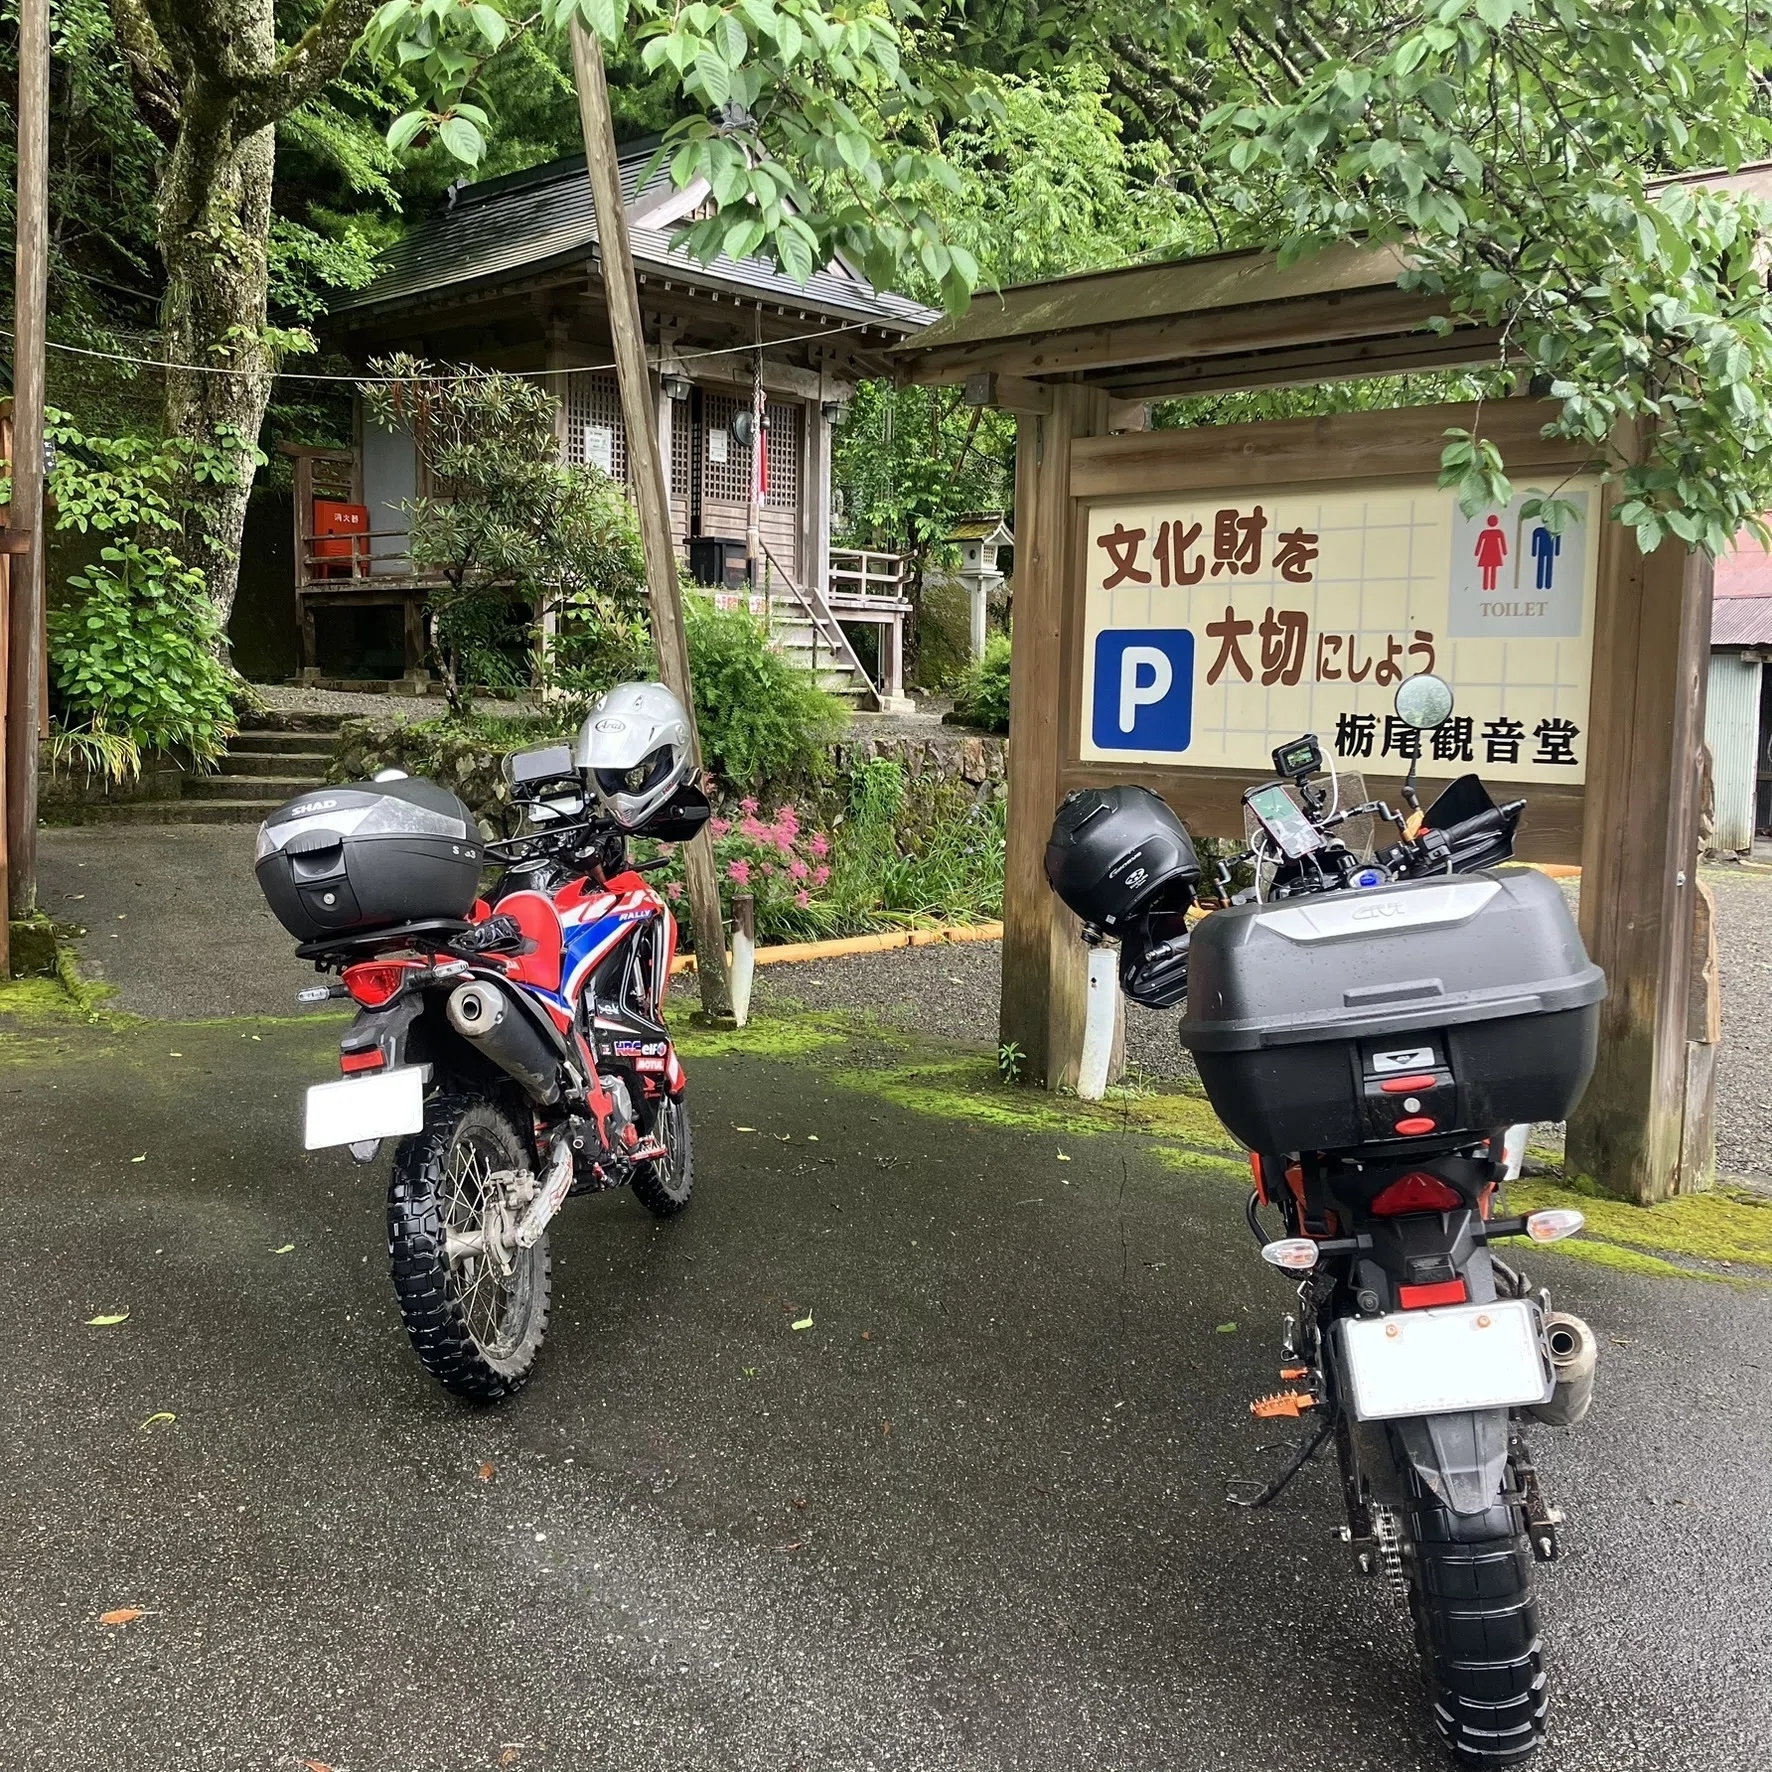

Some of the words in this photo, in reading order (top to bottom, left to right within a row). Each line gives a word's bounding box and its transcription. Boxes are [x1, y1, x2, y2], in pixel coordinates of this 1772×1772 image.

[1097, 505, 1319, 590] 文化財を
[1480, 601, 1549, 617] TOILET
[1206, 605, 1436, 687] 大切にしよう
[1119, 646, 1173, 733] P
[600, 720, 623, 731] Arai
[291, 800, 337, 817] SHAD
[619, 909, 651, 921] RALLY
[641, 1043, 658, 1056] elf
[637, 1059, 664, 1070] MOTUL
